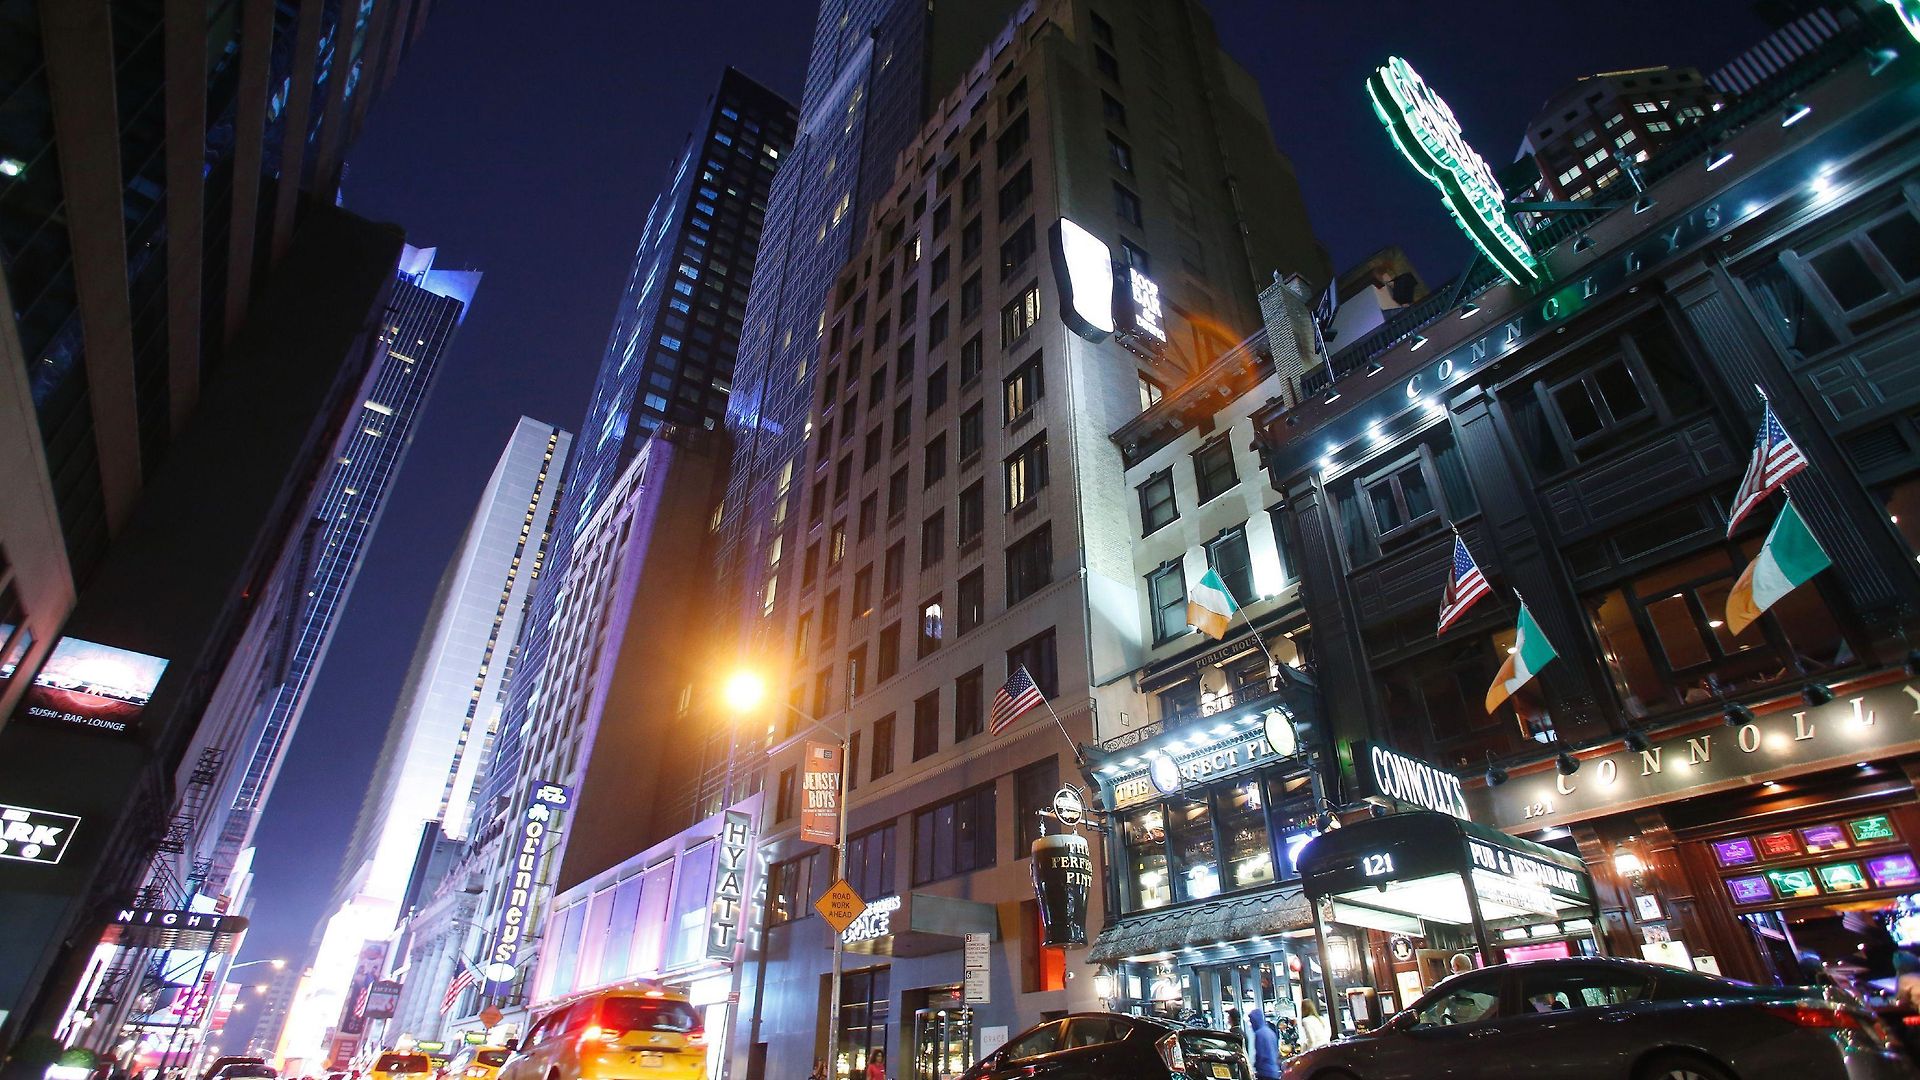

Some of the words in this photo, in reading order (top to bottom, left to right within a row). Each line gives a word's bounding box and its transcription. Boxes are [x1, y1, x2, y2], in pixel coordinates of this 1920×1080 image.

[1406, 203, 1720, 399] CONNOLLY'S
[1196, 648, 1229, 669] PUBLIC
[1232, 632, 1264, 655] HOUSE
[28, 706, 59, 719] SUSHI
[63, 713, 83, 723] BAR
[88, 717, 126, 732] LOUNGE
[802, 772, 840, 791] JERSEY
[1115, 778, 1150, 802] THE
[1371, 745, 1472, 823] CONNOLLY'S
[808, 789, 836, 809] BOYS
[1523, 800, 1556, 819] 121
[1065, 842, 1090, 857] THE
[1362, 852, 1395, 877] 121
[1469, 841, 1497, 870] PUB
[1497, 850, 1511, 874] &
[1509, 853, 1580, 894] RESTAURANT
[717, 822, 747, 946] HYATT
[832, 892, 851, 900] ROAD
[118, 910, 221, 928] NIGHT
